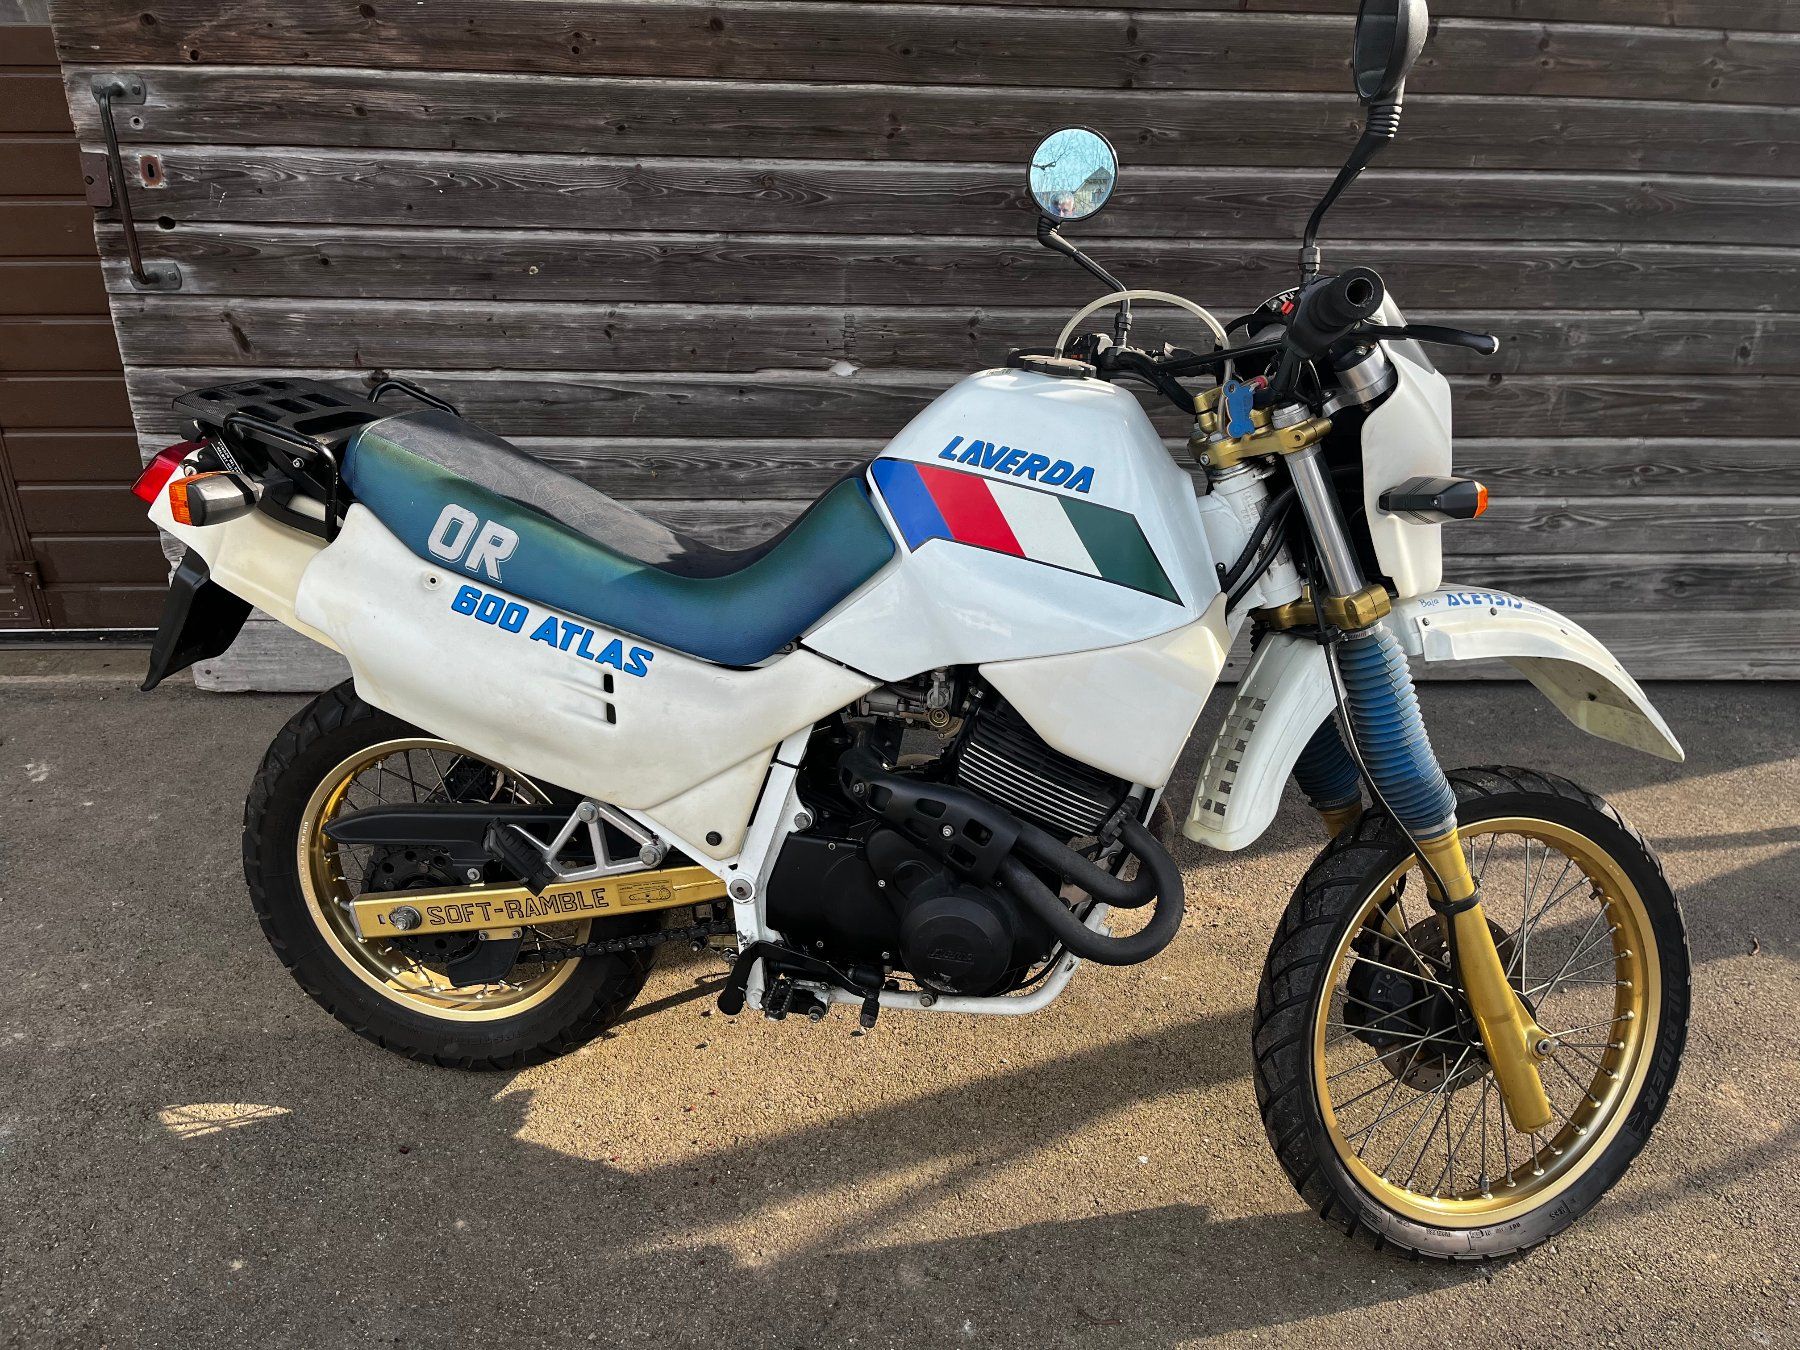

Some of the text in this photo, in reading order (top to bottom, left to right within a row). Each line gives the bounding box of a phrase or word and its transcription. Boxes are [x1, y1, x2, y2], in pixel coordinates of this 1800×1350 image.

[938, 436, 1095, 494] LAVERDA
[427, 503, 520, 583] OR
[451, 584, 654, 678] 600 ATLAS
[1418, 598, 1440, 608] Baja
[426, 887, 610, 926] SOFT-RAMBLE
